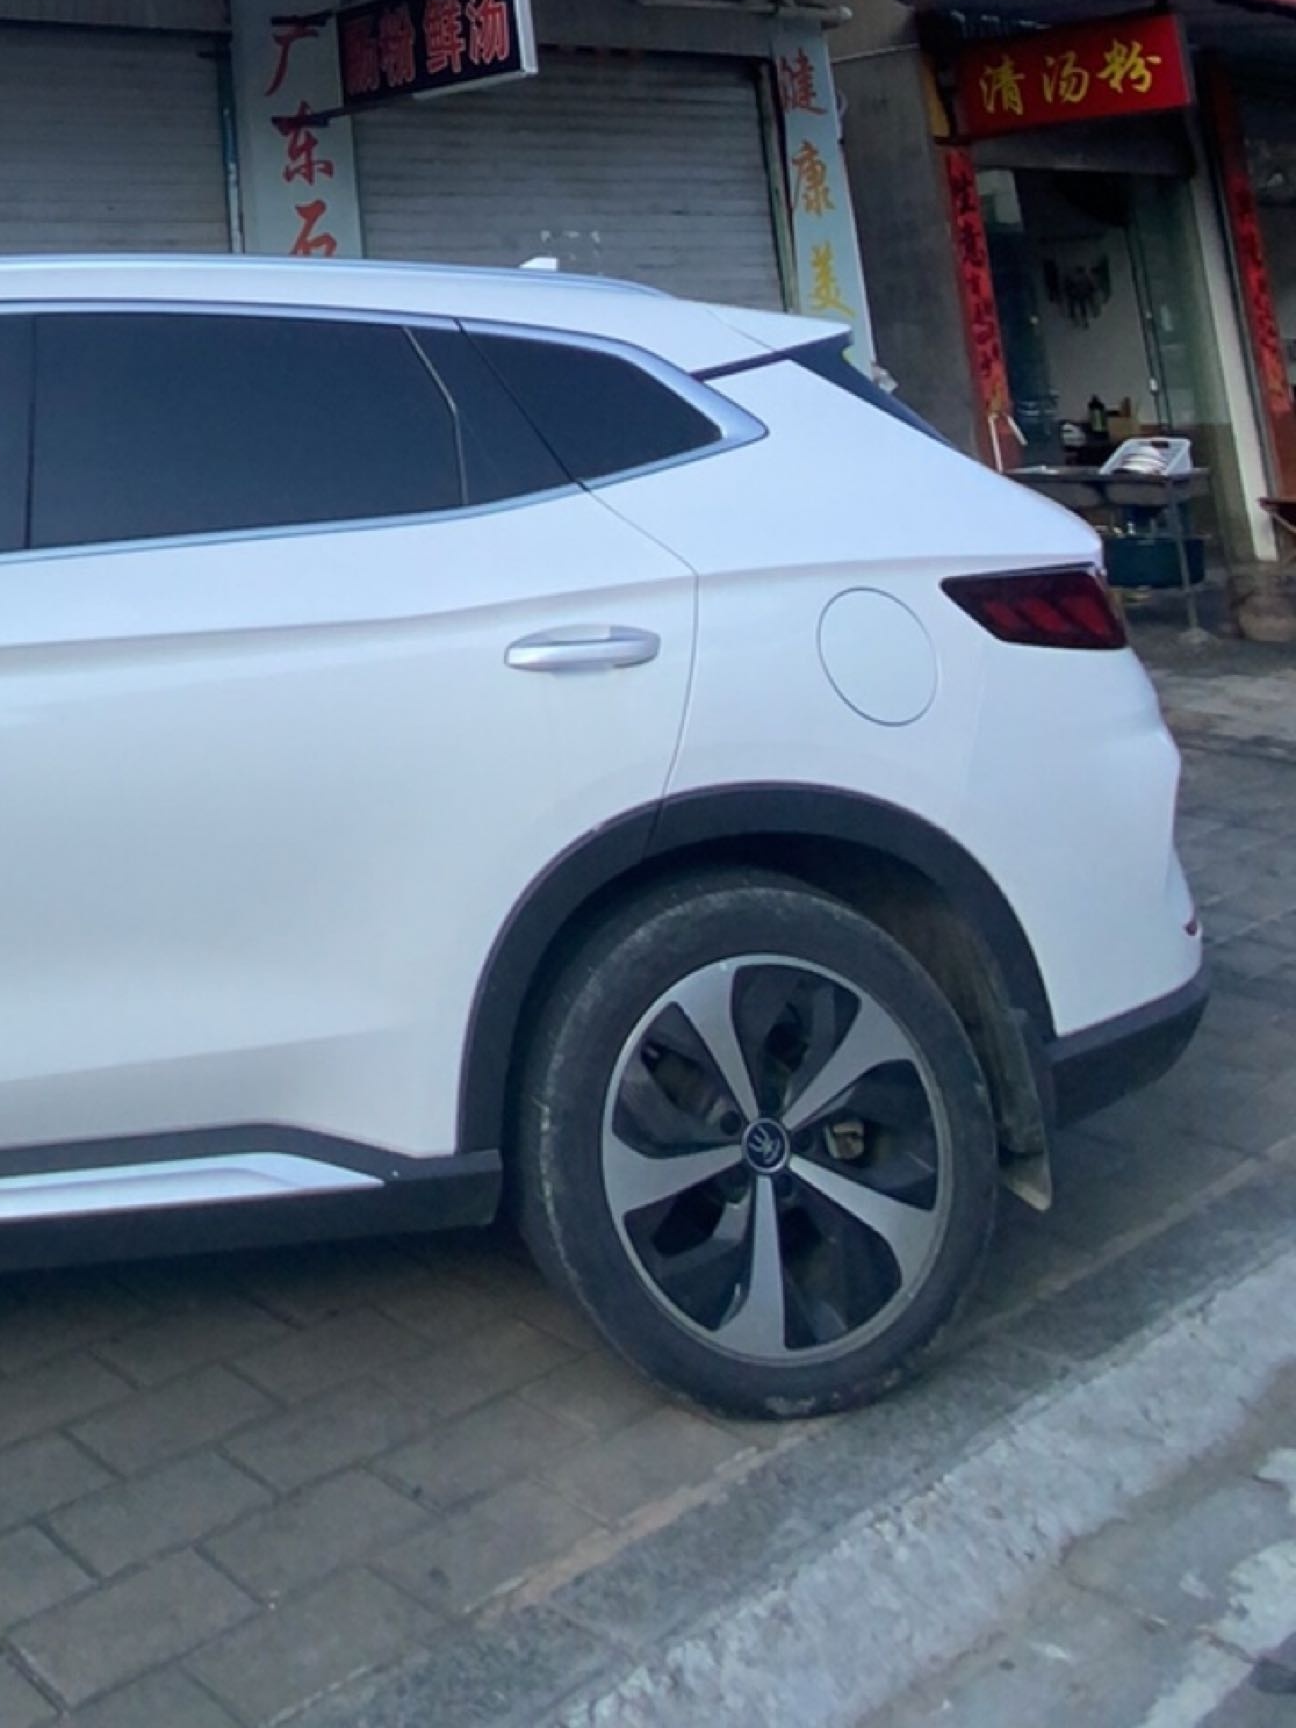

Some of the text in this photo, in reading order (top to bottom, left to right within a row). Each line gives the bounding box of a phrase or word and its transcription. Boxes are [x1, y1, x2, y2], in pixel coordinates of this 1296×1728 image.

[978, 39, 1163, 116] 清汤粉
[776, 46, 859, 364] 健康美
